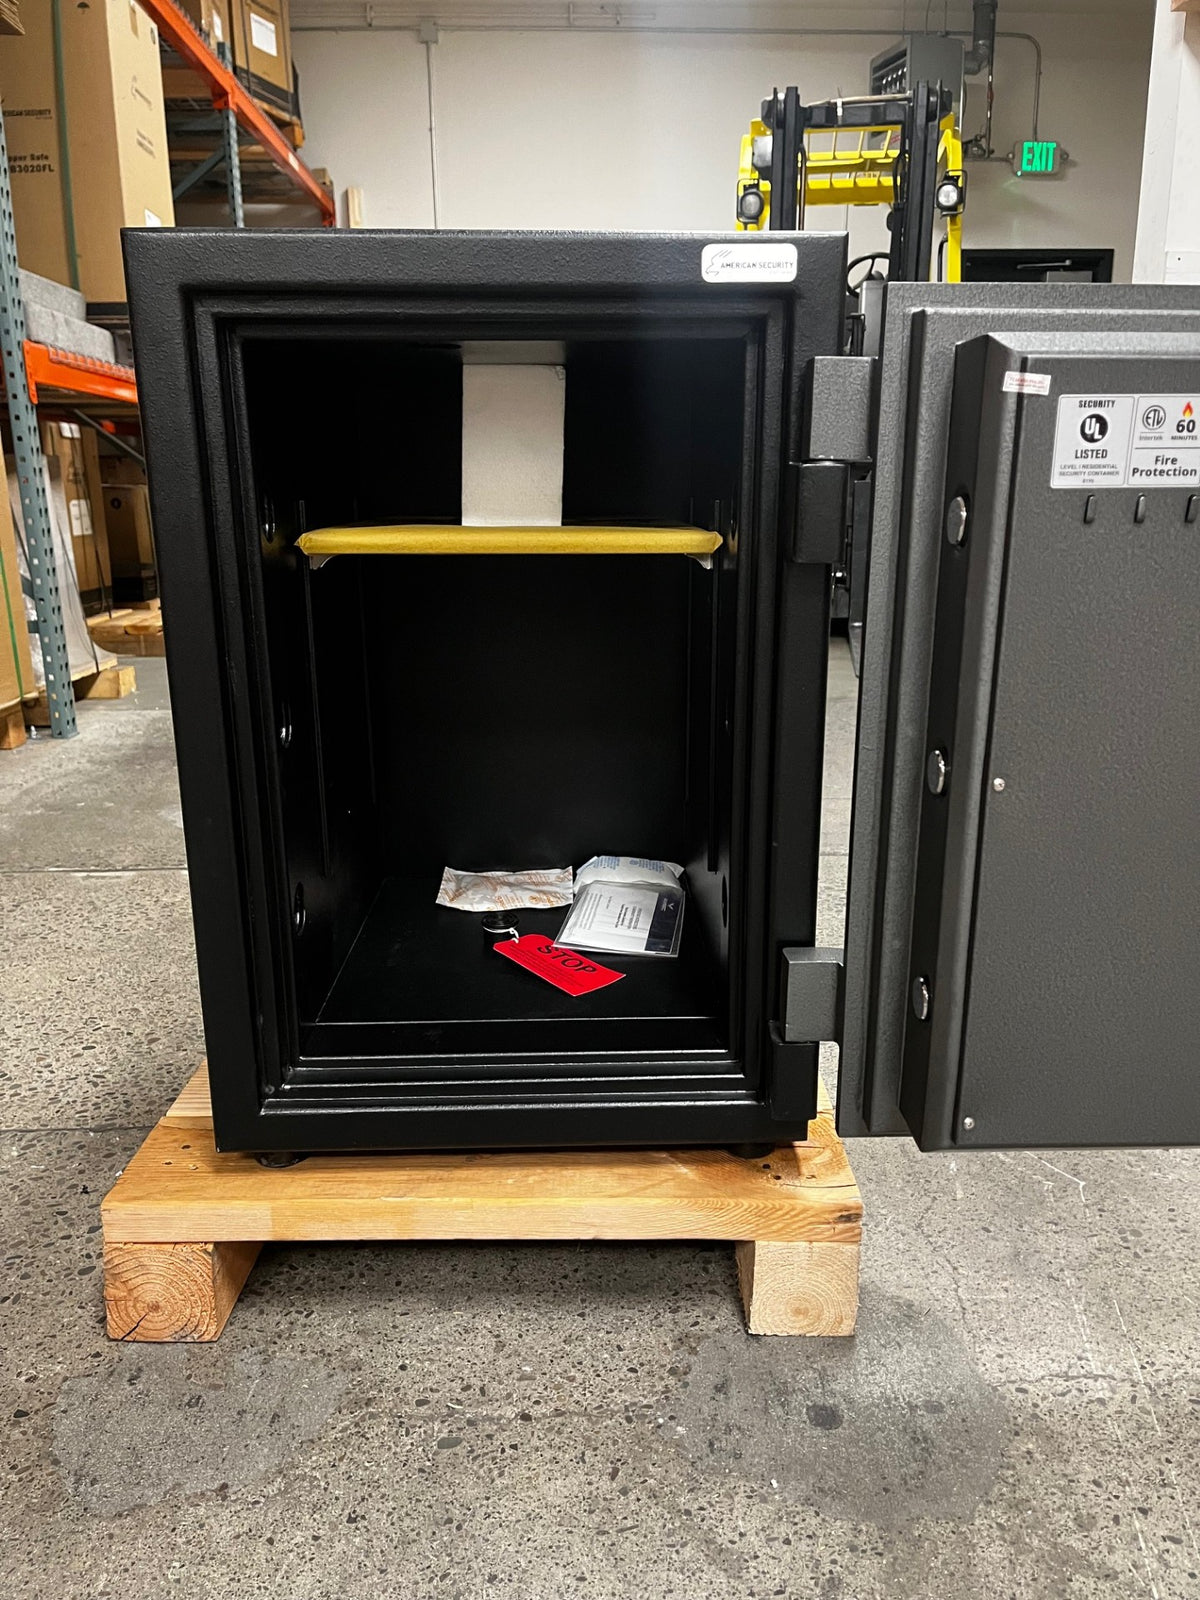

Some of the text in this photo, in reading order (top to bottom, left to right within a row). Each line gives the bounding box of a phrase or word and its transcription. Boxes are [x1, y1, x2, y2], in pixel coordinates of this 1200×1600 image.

[1022, 141, 1057, 172] EXIT
[10, 164, 54, 173] B3020FL
[1078, 400, 1116, 408] SECURITY
[1084, 418, 1102, 440] UL
[1176, 419, 1196, 434] 60
[1074, 449, 1108, 459] LISTED
[1154, 454, 1178, 466] Fire
[1132, 466, 1198, 478] Protection
[536, 944, 597, 974] STOP
